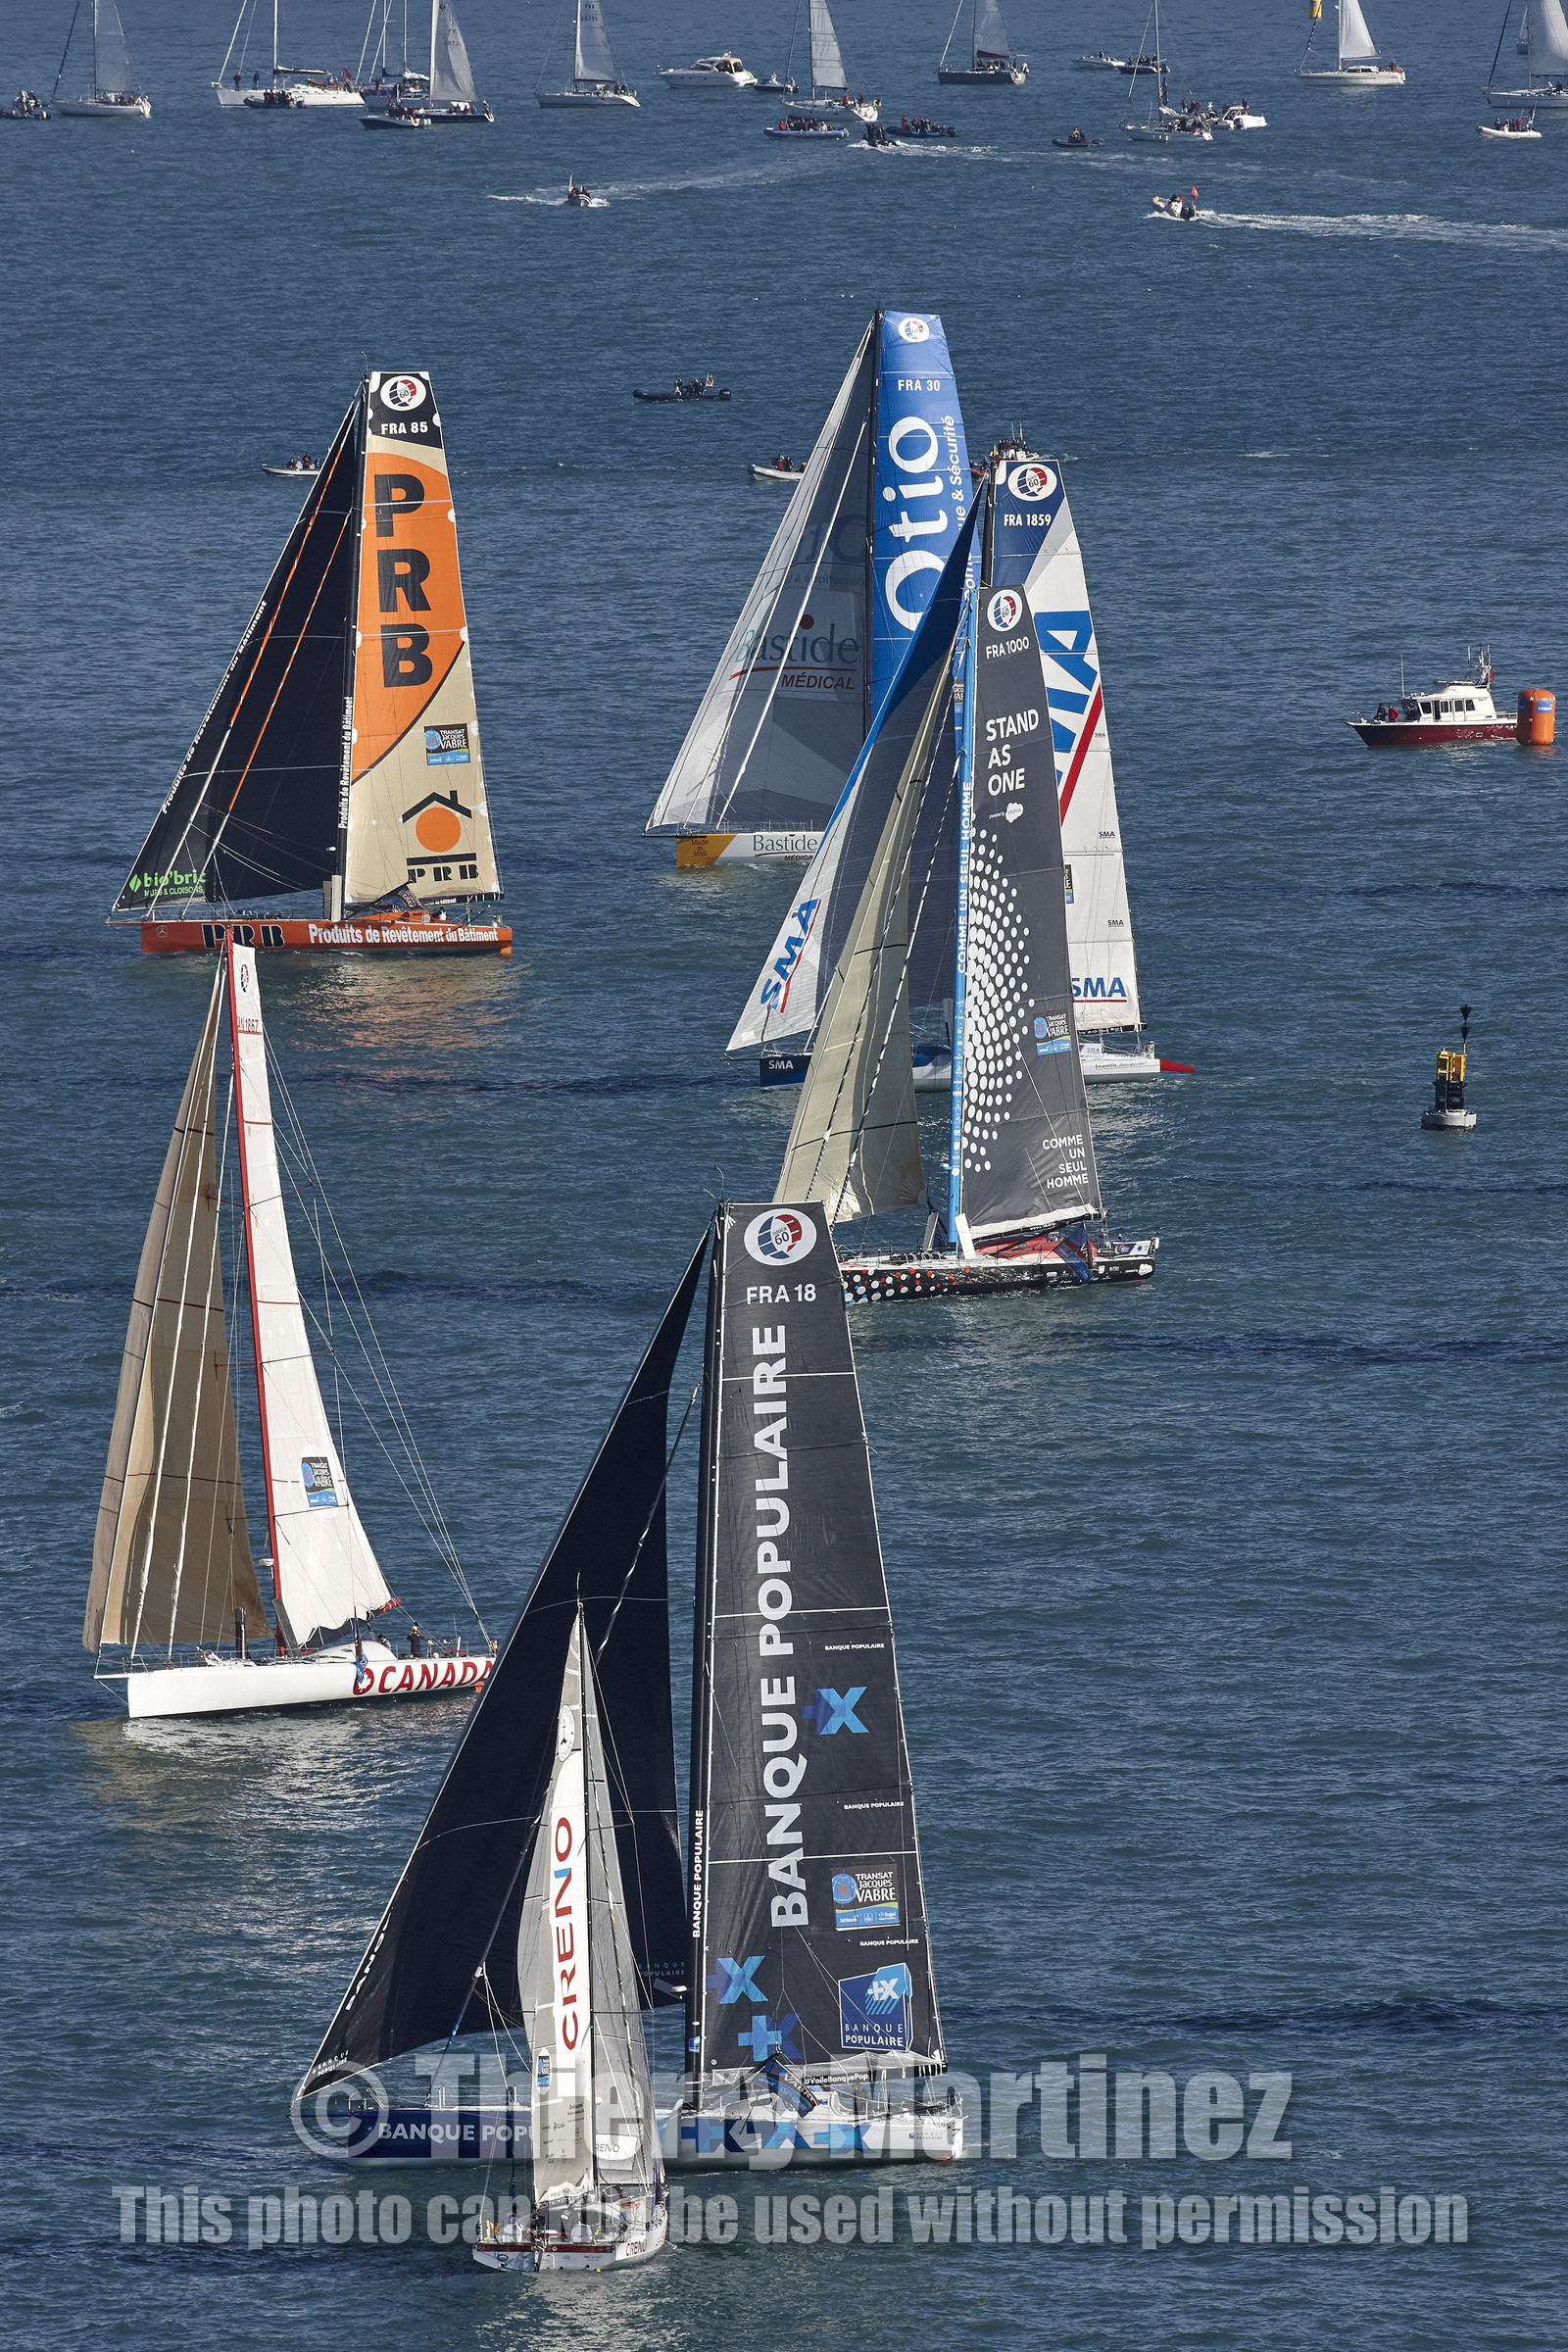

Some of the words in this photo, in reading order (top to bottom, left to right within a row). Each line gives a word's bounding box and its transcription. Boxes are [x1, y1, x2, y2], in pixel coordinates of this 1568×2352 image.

[399, 389, 410, 399] 60
[898, 379, 922, 391] FRA
[926, 379, 941, 391] 30
[380, 422, 407, 435] FRA
[411, 421, 428, 433] 85
[940, 415, 963, 486] Sécurité
[1028, 478, 1039, 487] 60
[1004, 514, 1023, 526] FRA
[1026, 514, 1052, 526] 1859
[736, 620, 858, 664] Bastide
[986, 643, 1005, 660] FRA
[1006, 636, 1029, 655] 1000
[782, 671, 855, 690] MÉDICAL
[986, 709, 1040, 742] STAND
[440, 739, 467, 750] VABRE
[988, 744, 1011, 769] AS
[988, 767, 1025, 797] ONE
[338, 796, 349, 829] Produits
[961, 781, 971, 841] HOMME
[754, 834, 818, 852] Bastide
[408, 864, 479, 883] PRB
[959, 844, 969, 884] SEUL
[958, 889, 968, 911] UN
[308, 923, 364, 944] Produits
[366, 925, 381, 943] de
[382, 925, 445, 943] Revêtement
[446, 927, 459, 942] du
[459, 927, 499, 942] Bâtiment
[760, 898, 819, 1010] SMA
[957, 915, 968, 974] COMME
[1071, 977, 1127, 998] SMA
[768, 1059, 794, 1070] SMA
[1042, 1134, 1084, 1150] COMME
[1069, 1147, 1085, 1159] UN
[1058, 1160, 1087, 1174] SEUL
[1047, 1173, 1089, 1189] HOMME
[774, 1231, 790, 1246] 60
[746, 1284, 790, 1305] FRA
[794, 1283, 816, 1302] 18
[752, 1324, 794, 1656] POPULAIRE
[378, 1660, 494, 1693] CANADA
[760, 1675, 809, 1928] BANQUE
[694, 1809, 704, 1882] POPULAIRE
[856, 1871, 894, 1881] TRANSAT
[855, 1887, 897, 1903] VABRE
[692, 1884, 703, 1938] BANQUE
[554, 1817, 578, 2051] CRENO
[845, 2024, 904, 2034] BANQUE
[845, 2034, 904, 2047] POPULAIRE
[377, 2123, 475, 2143] BANQUE
[595, 2143, 620, 2152] RENO
